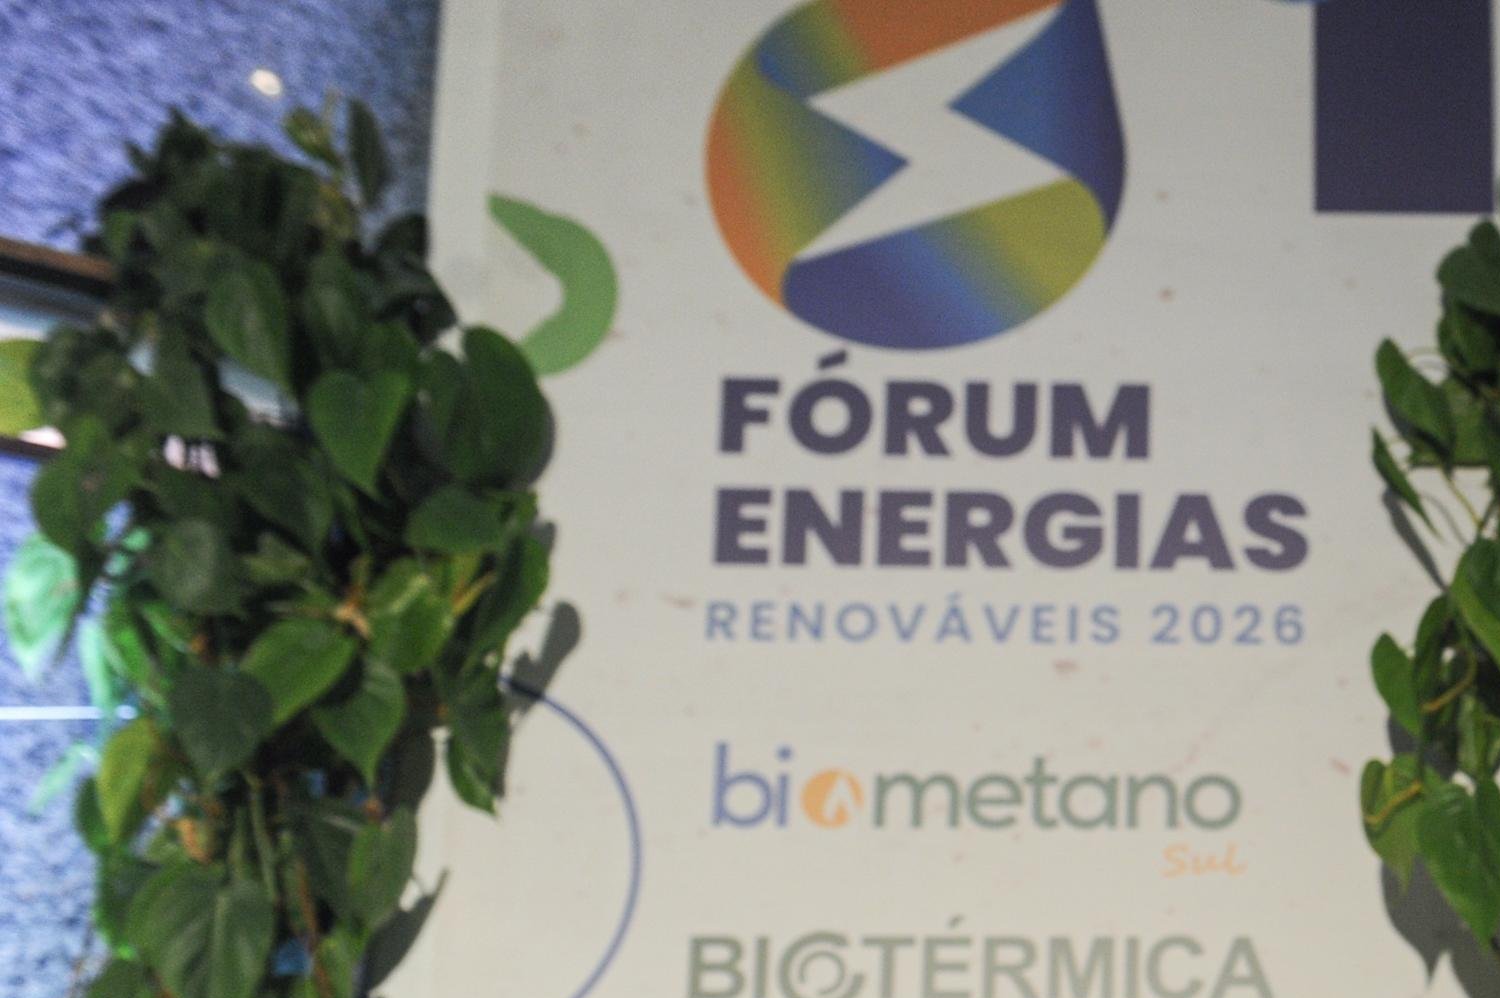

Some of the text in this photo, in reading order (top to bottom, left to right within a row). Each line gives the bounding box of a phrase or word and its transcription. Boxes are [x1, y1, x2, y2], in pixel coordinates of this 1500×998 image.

[718, 350, 1152, 460] FÓRUM
[712, 487, 1310, 572] ENERGIAS
[703, 593, 1306, 646] RENOVÁVEIS 2026
[711, 741, 1243, 830] biometano
[1159, 842, 1248, 878] Sul
